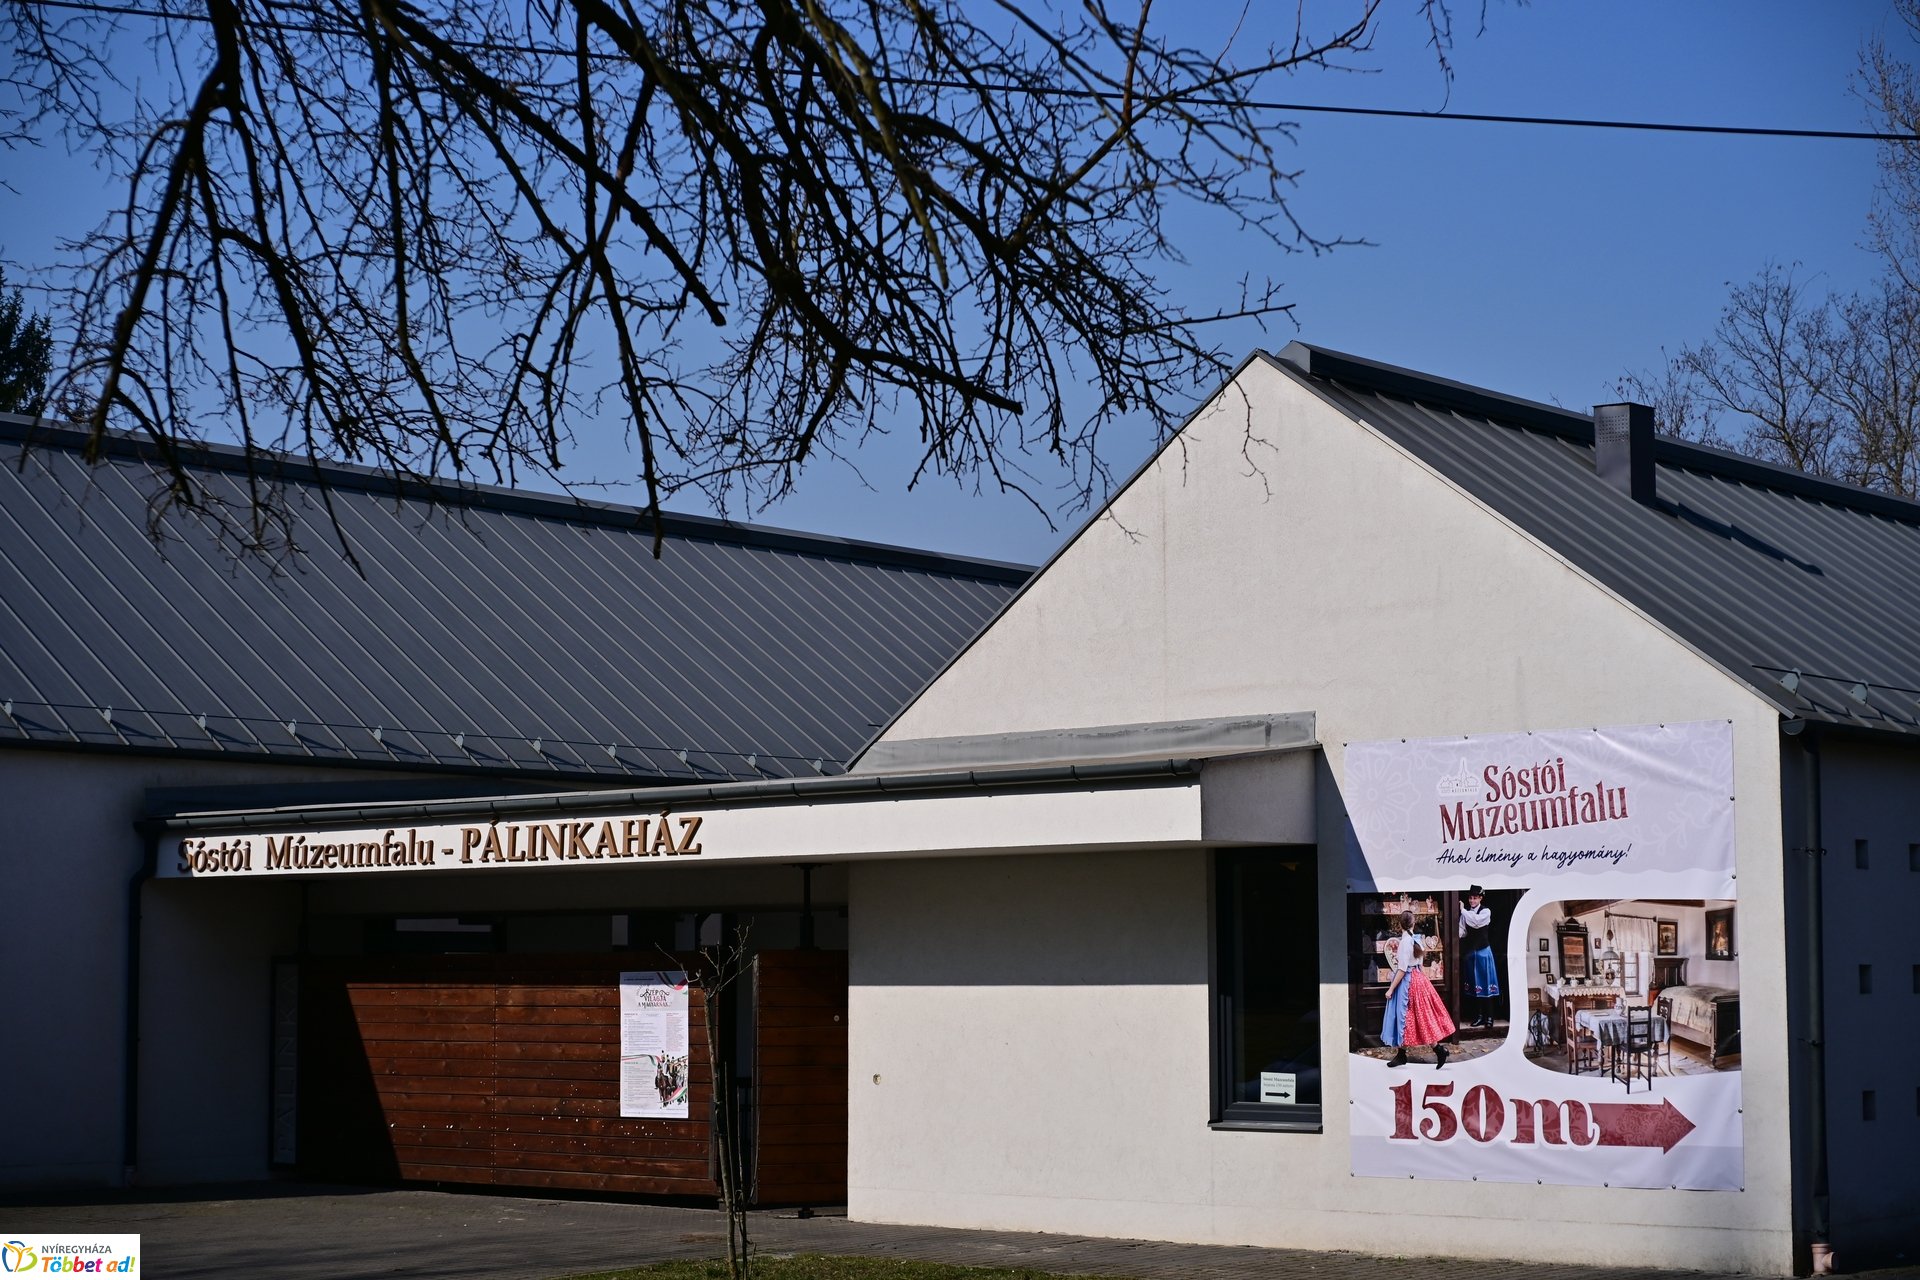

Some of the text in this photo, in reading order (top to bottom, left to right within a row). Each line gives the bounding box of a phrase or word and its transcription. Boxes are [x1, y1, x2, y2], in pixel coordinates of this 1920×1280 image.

[1483, 757, 1567, 803] Sóstói
[1439, 780, 1629, 844] Múzeumfalu
[178, 838, 252, 874] Sóstói
[264, 828, 435, 871] Múzeumfalu
[459, 808, 703, 864] PÁLINKAHÁZ
[1436, 843, 1632, 869] Ahol élmény a hagyomány!
